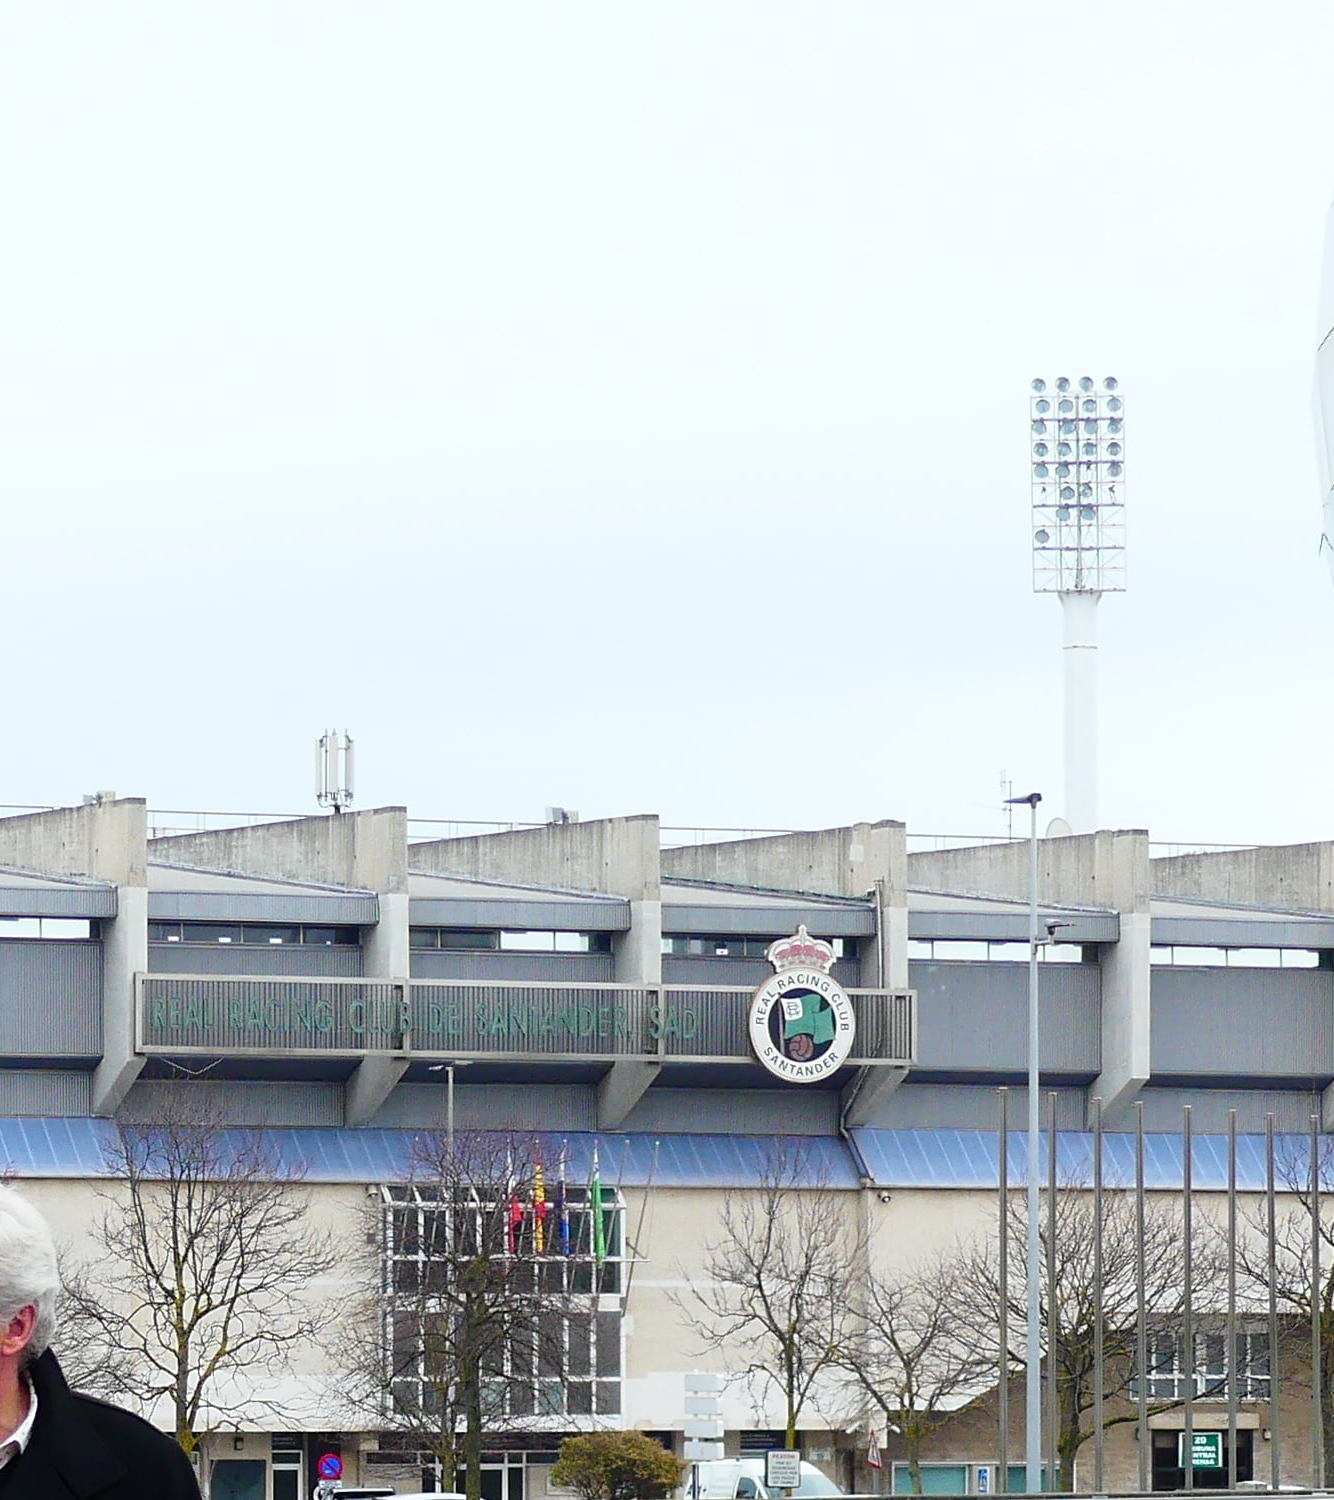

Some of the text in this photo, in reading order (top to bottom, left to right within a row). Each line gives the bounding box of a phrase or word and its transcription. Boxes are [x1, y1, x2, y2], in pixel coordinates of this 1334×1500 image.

[151, 998, 216, 1031] REAL
[227, 999, 333, 1034] RACING
[349, 999, 412, 1034] CLUB
[428, 1001, 462, 1035] DE
[648, 1005, 697, 1039] SAD
[755, 973, 850, 1031] REAL RACING CLUB
[763, 1046, 840, 1077] SANTANDER
